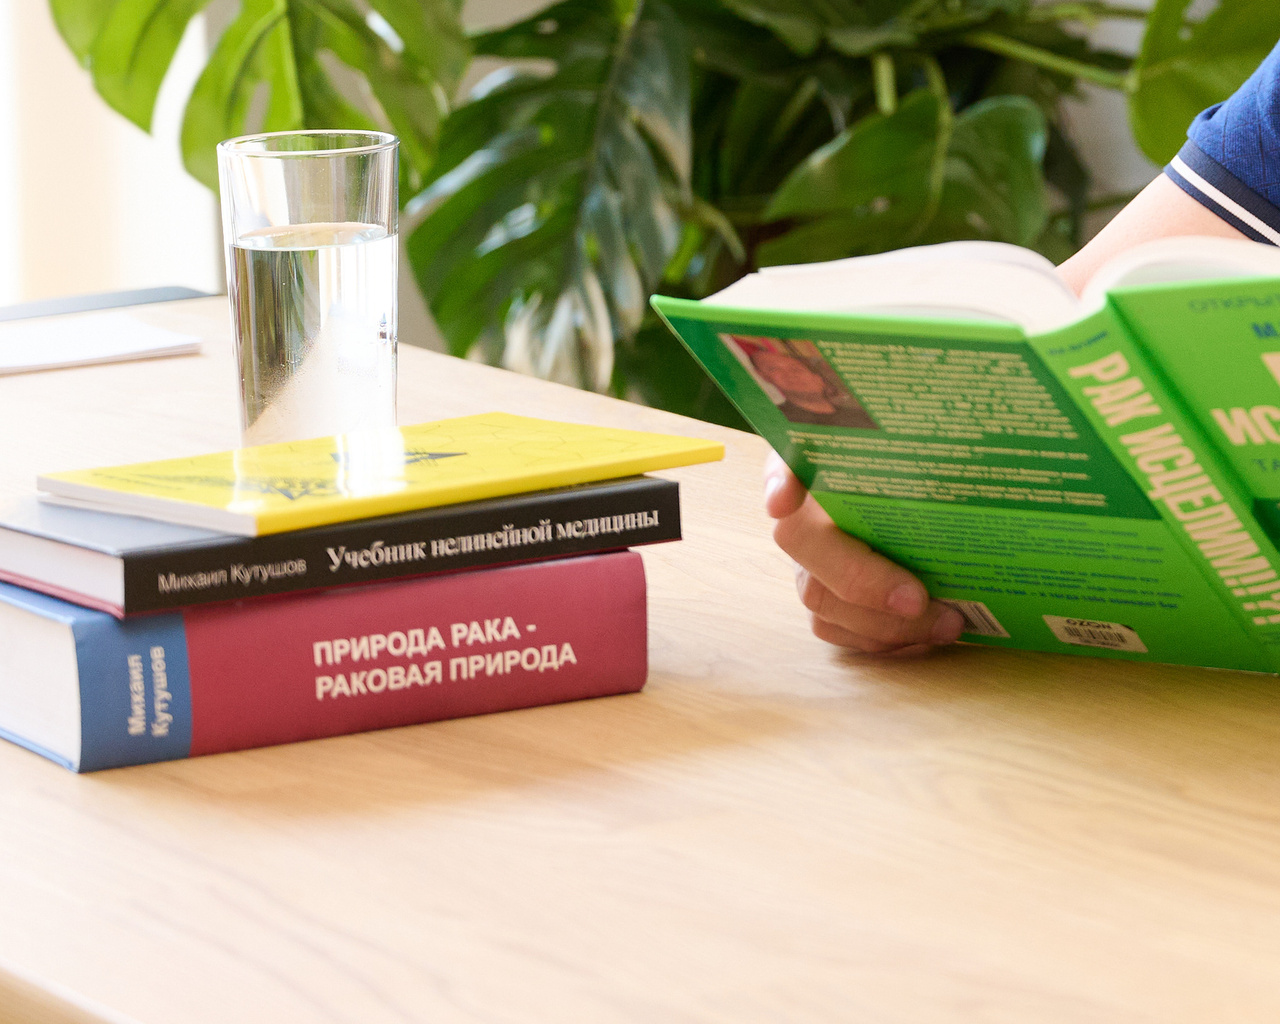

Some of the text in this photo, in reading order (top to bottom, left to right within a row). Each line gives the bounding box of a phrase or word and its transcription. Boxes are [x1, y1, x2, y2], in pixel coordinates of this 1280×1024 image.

[1068, 351, 1160, 426] РАК
[157, 509, 660, 594] Михаил Кутушов Учебник нелинейной медицины
[313, 627, 446, 667] ПРИРОДА
[450, 616, 521, 647] РАКА
[314, 643, 578, 701] РАКОВАЯ ПРИРОДА
[127, 654, 147, 736] Михаил
[150, 645, 173, 737] Кутушов
